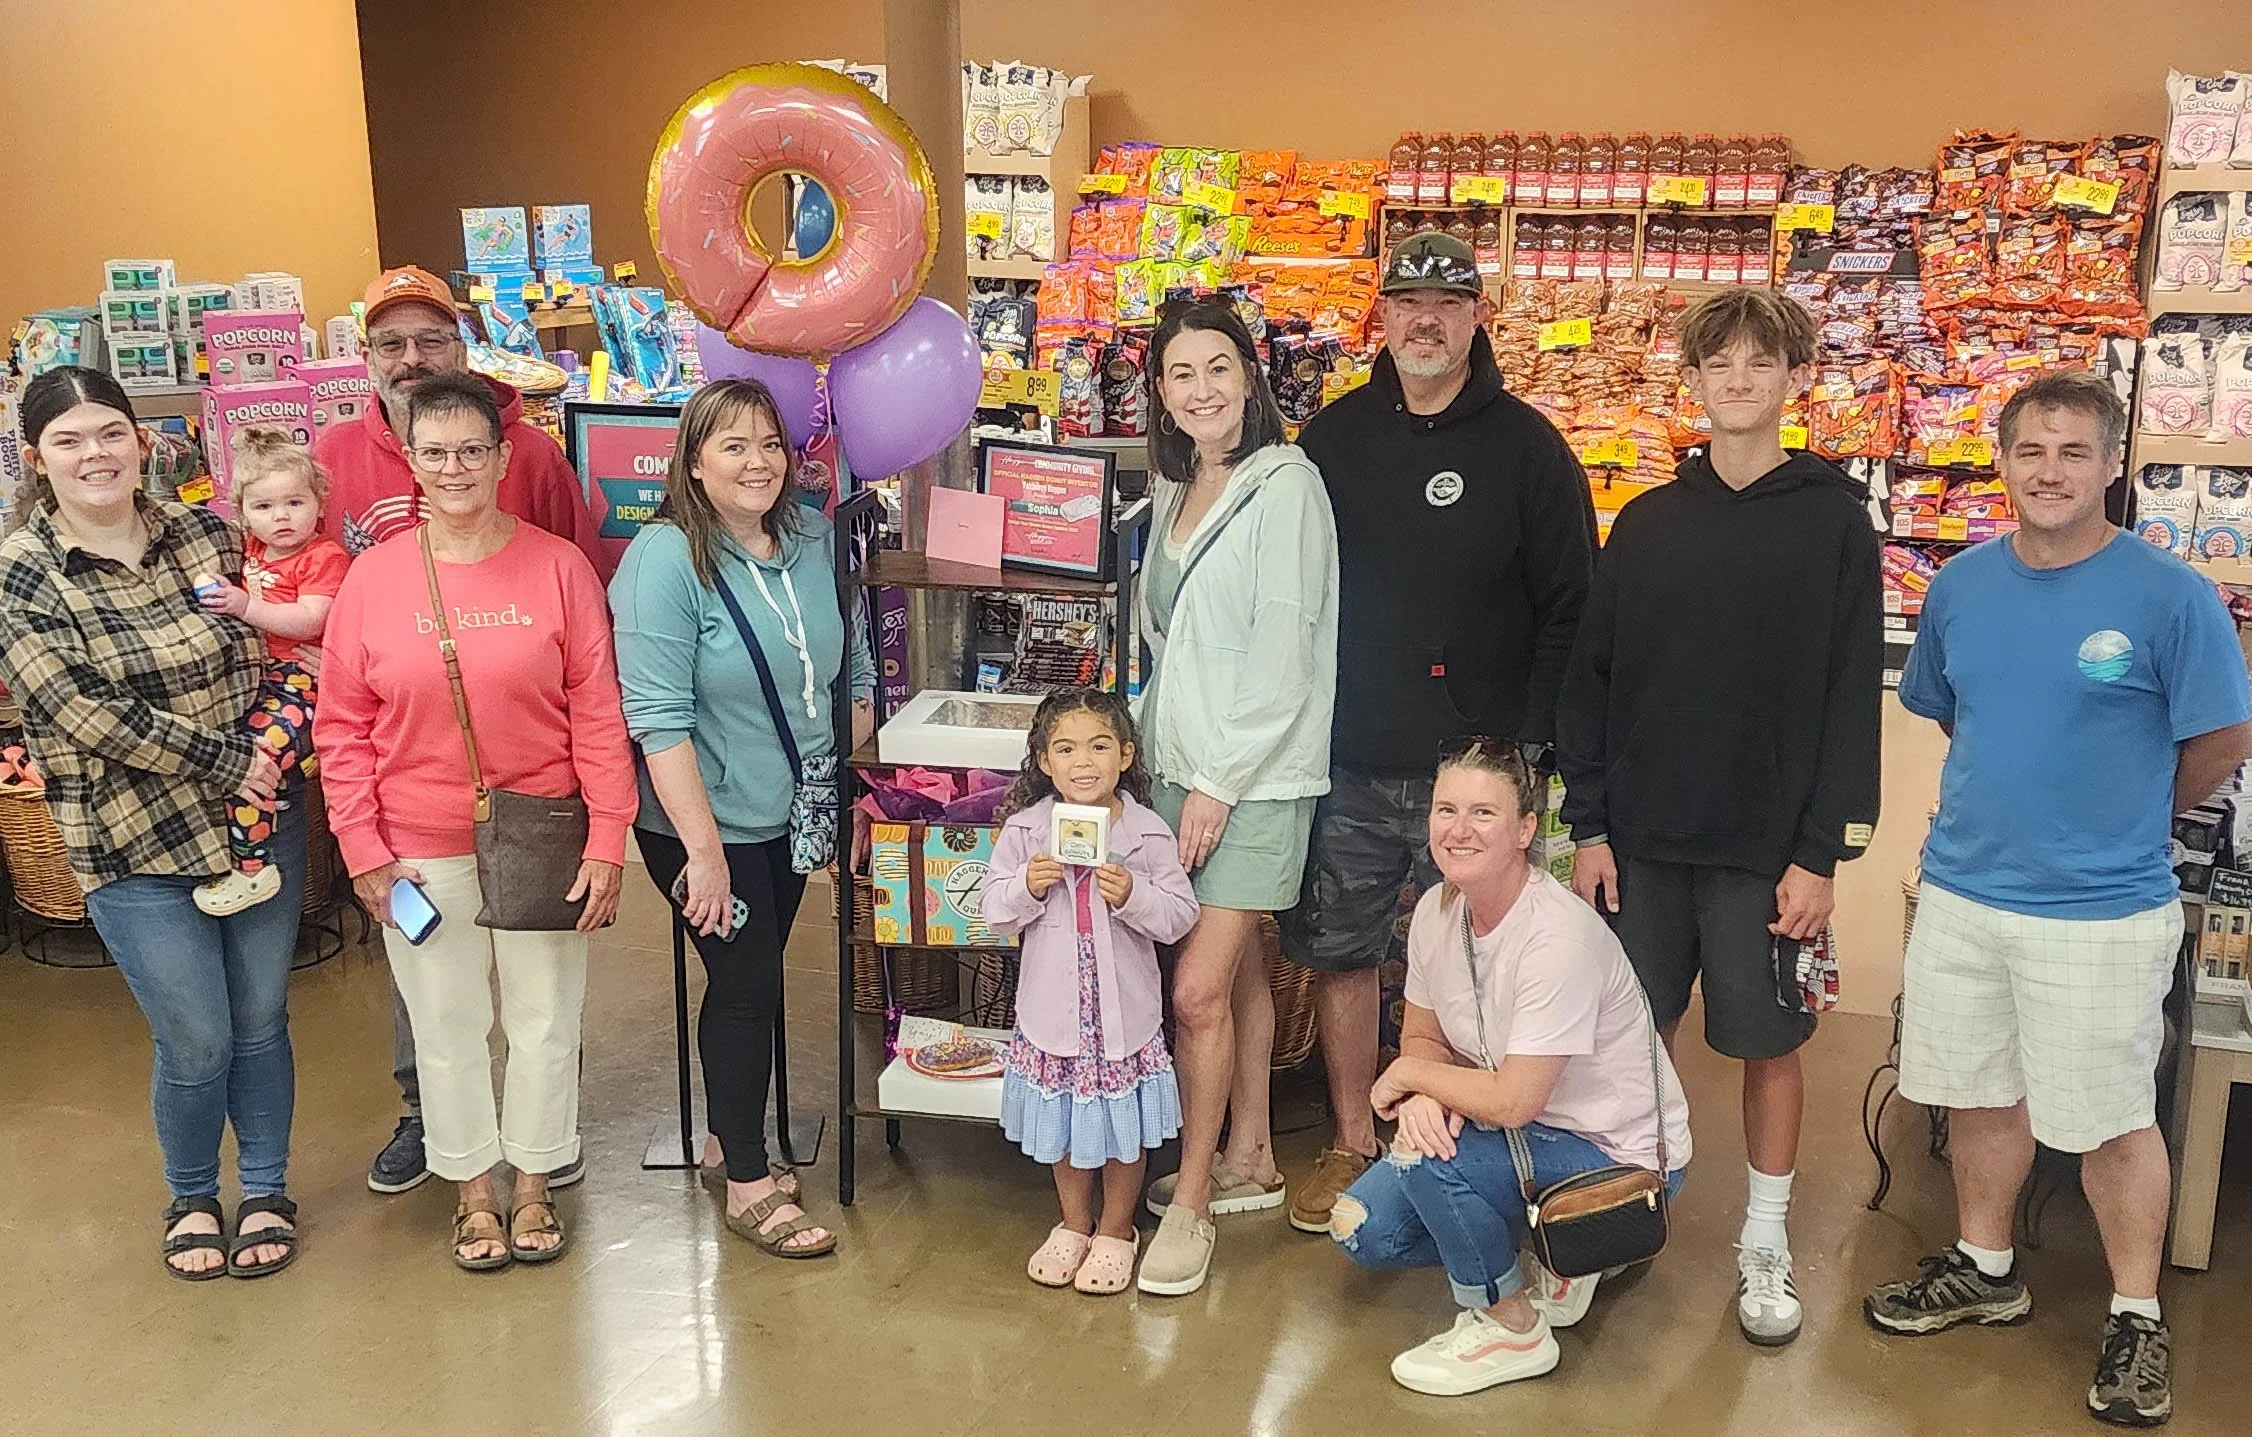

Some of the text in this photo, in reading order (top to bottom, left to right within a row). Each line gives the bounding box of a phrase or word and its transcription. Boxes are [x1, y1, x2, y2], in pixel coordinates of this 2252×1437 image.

[1251, 234, 1301, 254] Reese's
[2168, 228, 2225, 243] POPCOR
[1832, 255, 1891, 270] SNICKERS
[211, 329, 297, 348] POPCORN
[1026, 376, 1047, 397] 899
[225, 403, 308, 424] POPCORN
[638, 489, 652, 502] WE
[1027, 503, 1059, 515] Sophia
[1033, 601, 1097, 622] HERSHEY'S
[951, 865, 989, 885] HAGGEN
